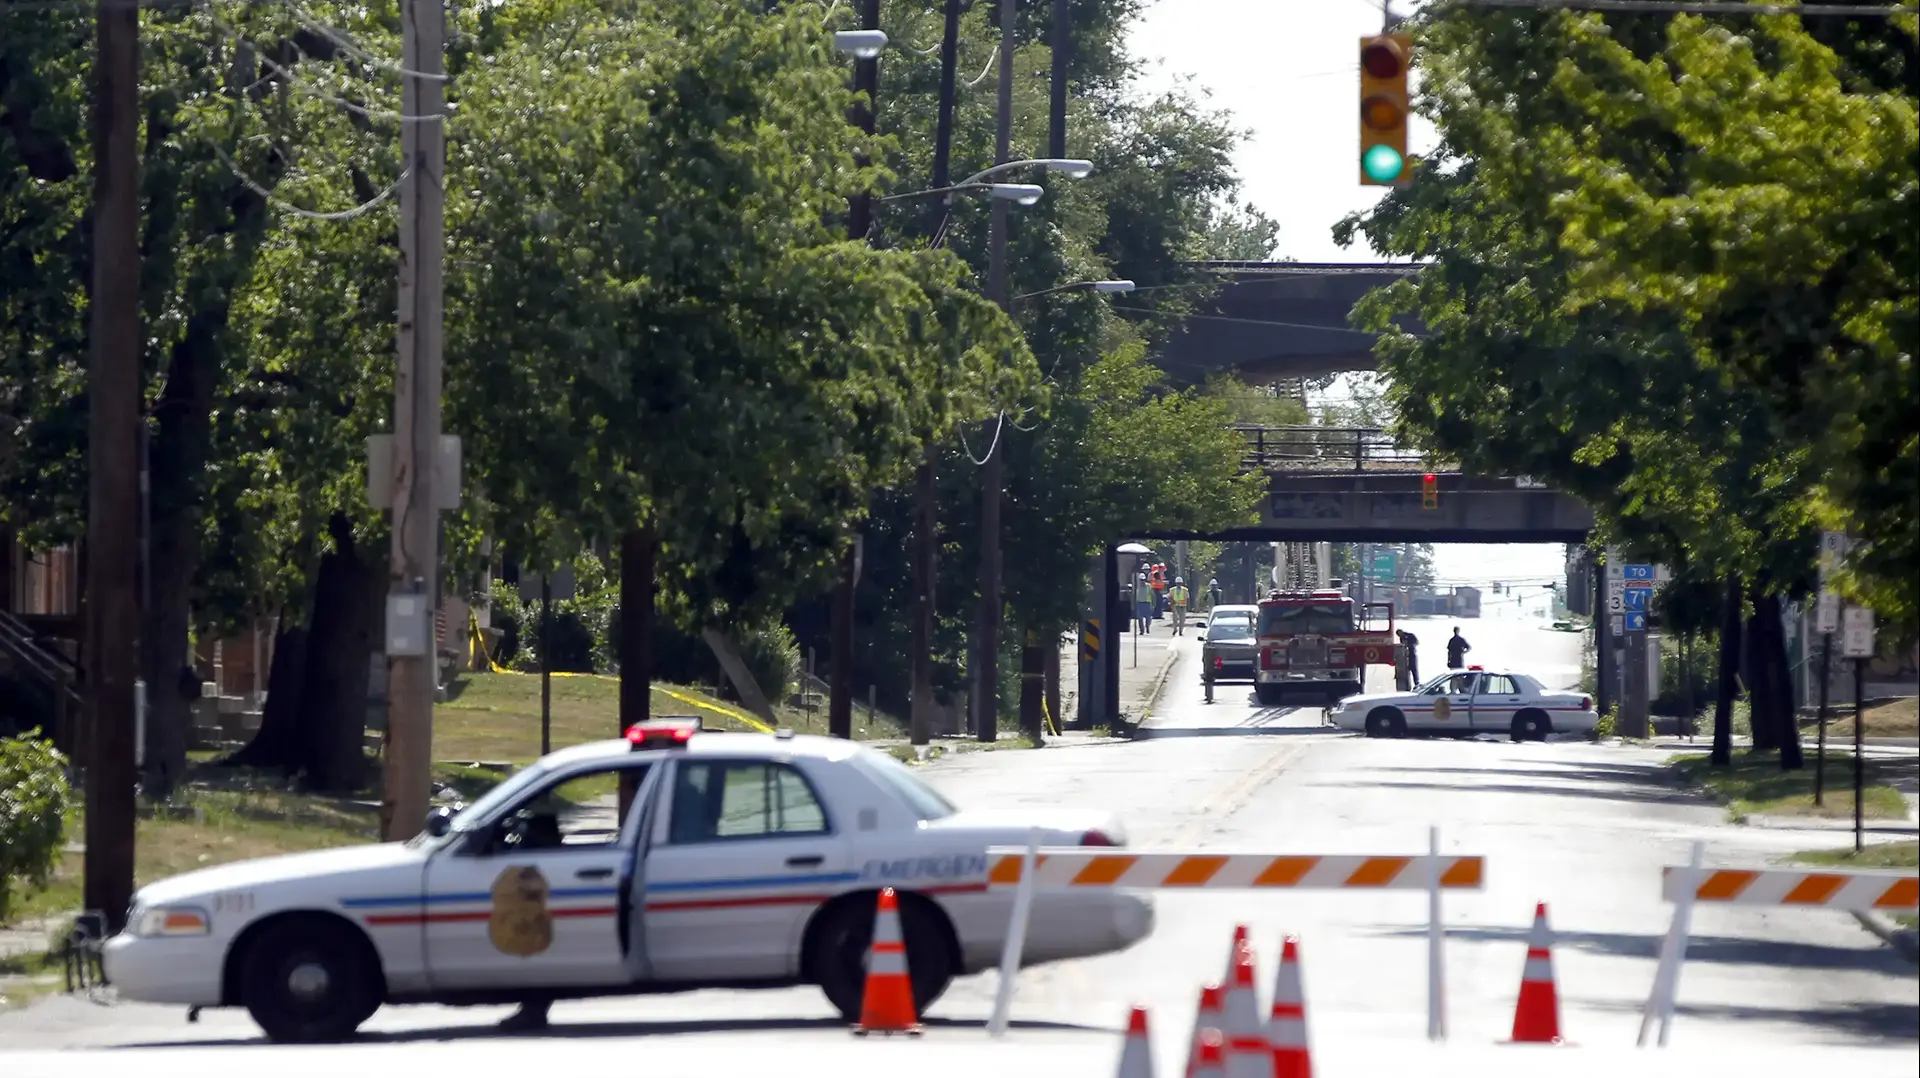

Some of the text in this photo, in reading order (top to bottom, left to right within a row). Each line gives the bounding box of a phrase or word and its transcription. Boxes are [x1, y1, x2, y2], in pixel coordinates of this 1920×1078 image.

[1631, 567, 1647, 577] TO
[1629, 590, 1646, 605] 71
[861, 853, 987, 878] EMERGEN
